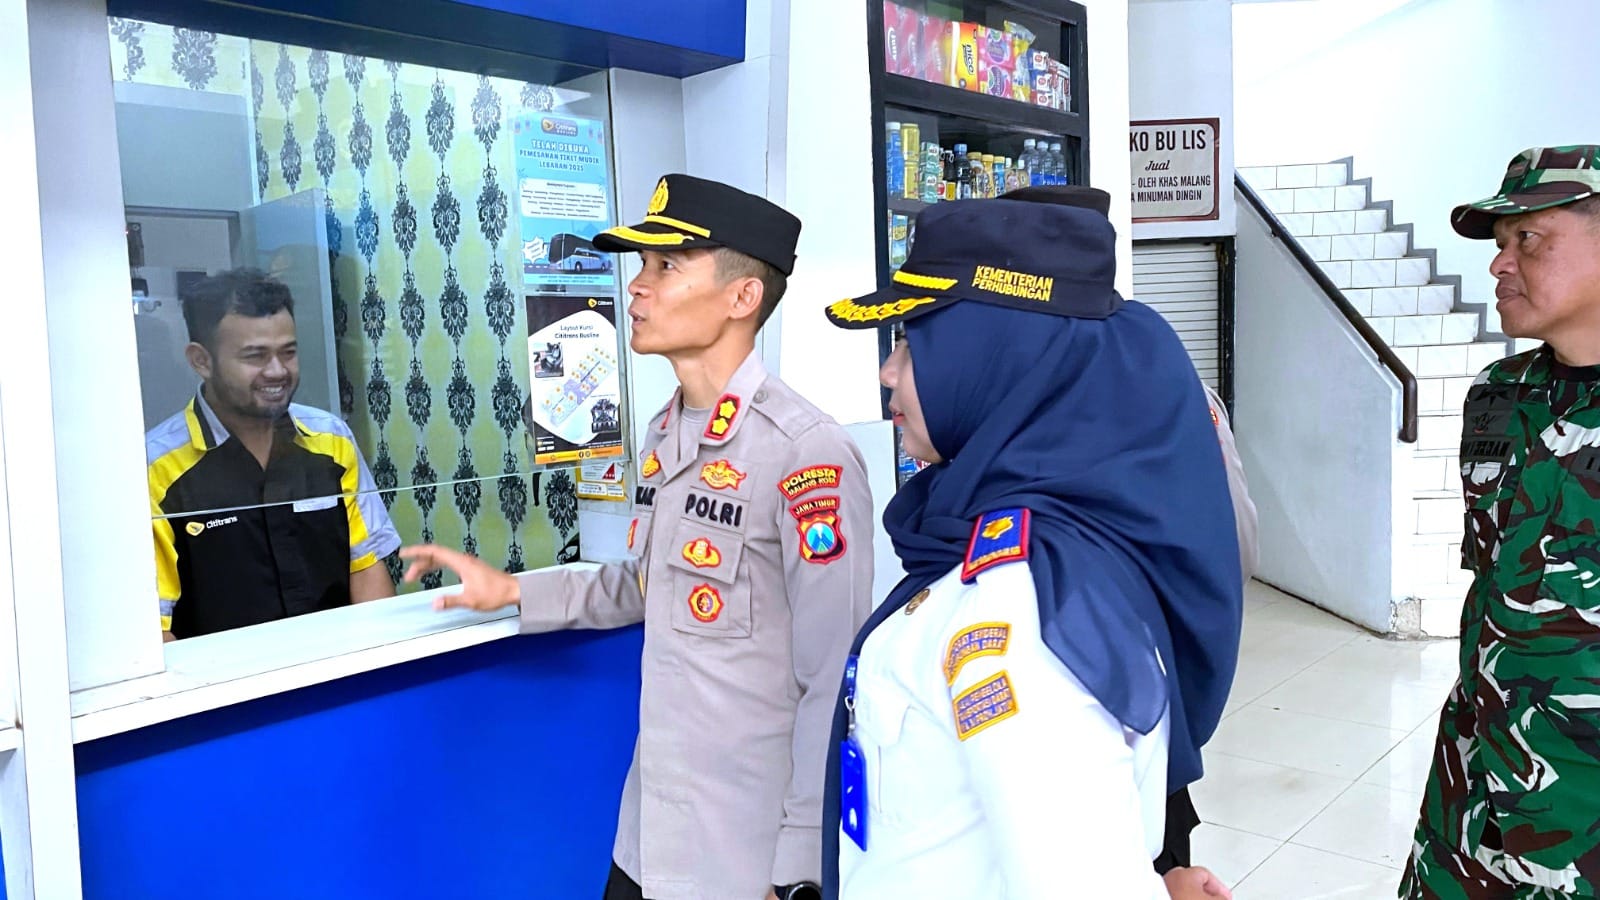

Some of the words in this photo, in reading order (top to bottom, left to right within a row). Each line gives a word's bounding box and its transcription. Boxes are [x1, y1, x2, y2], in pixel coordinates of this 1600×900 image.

[532, 140, 557, 150] TELAH
[558, 143, 590, 154] DIBUKA
[1156, 131, 1176, 151] BU
[1183, 129, 1206, 150] LIS
[519, 149, 559, 160] PEMESANAN
[560, 154, 577, 162] TIKET
[578, 156, 600, 164] MUDIK
[539, 161, 568, 170] LEBARAN
[569, 163, 584, 172] 2025
[1145, 160, 1170, 171] Jual
[1138, 177, 1156, 188] OLEH
[1158, 176, 1178, 187] KHAS
[1180, 175, 1211, 187] MALANG
[1138, 190, 1173, 202] MINUMAN
[1176, 189, 1202, 201] DINGIN
[975, 265, 1053, 291] KEMENTERIAN
[971, 277, 1051, 302] PERHUBUNGAN
[782, 468, 837, 491] POLRESTA
[788, 479, 817, 497] MALANG
[685, 493, 743, 528] POLRI
[795, 500, 815, 515] JAWA
[815, 499, 836, 508] TIMUR
